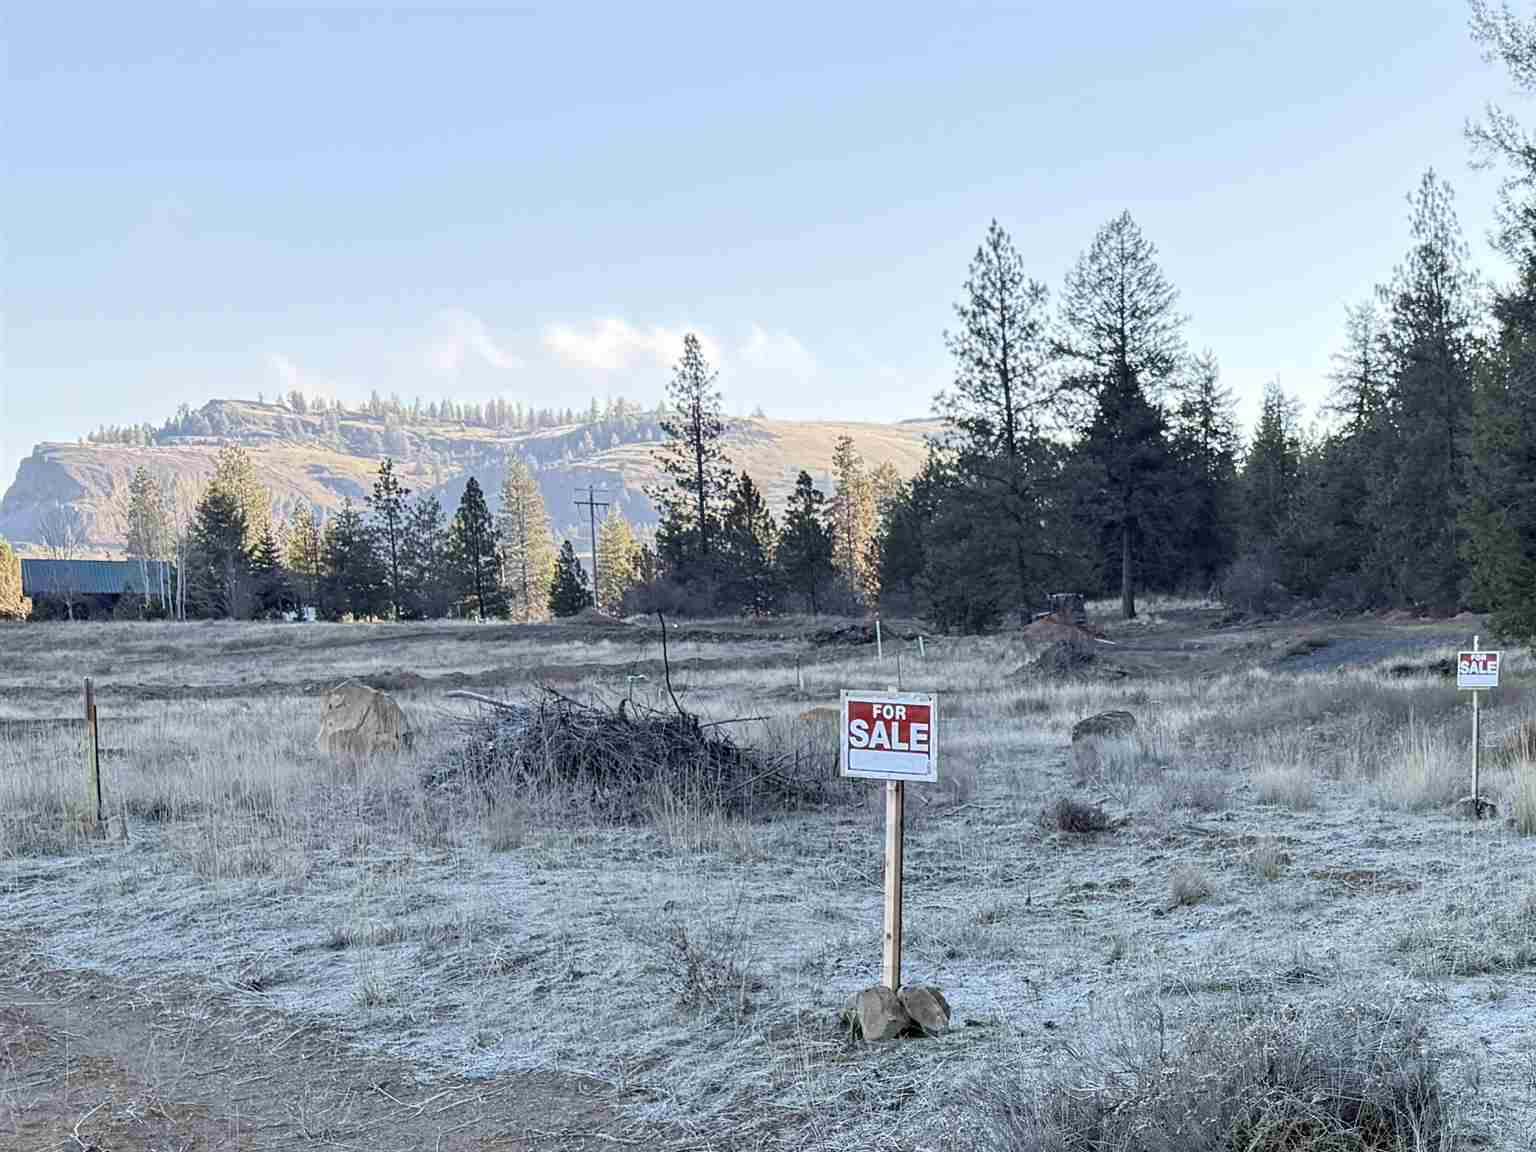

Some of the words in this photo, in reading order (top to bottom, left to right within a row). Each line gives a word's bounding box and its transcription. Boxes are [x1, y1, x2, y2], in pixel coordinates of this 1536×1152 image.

[1460, 660, 1497, 674] SALE
[872, 704, 906, 720] FOR
[849, 719, 929, 752] SALE
